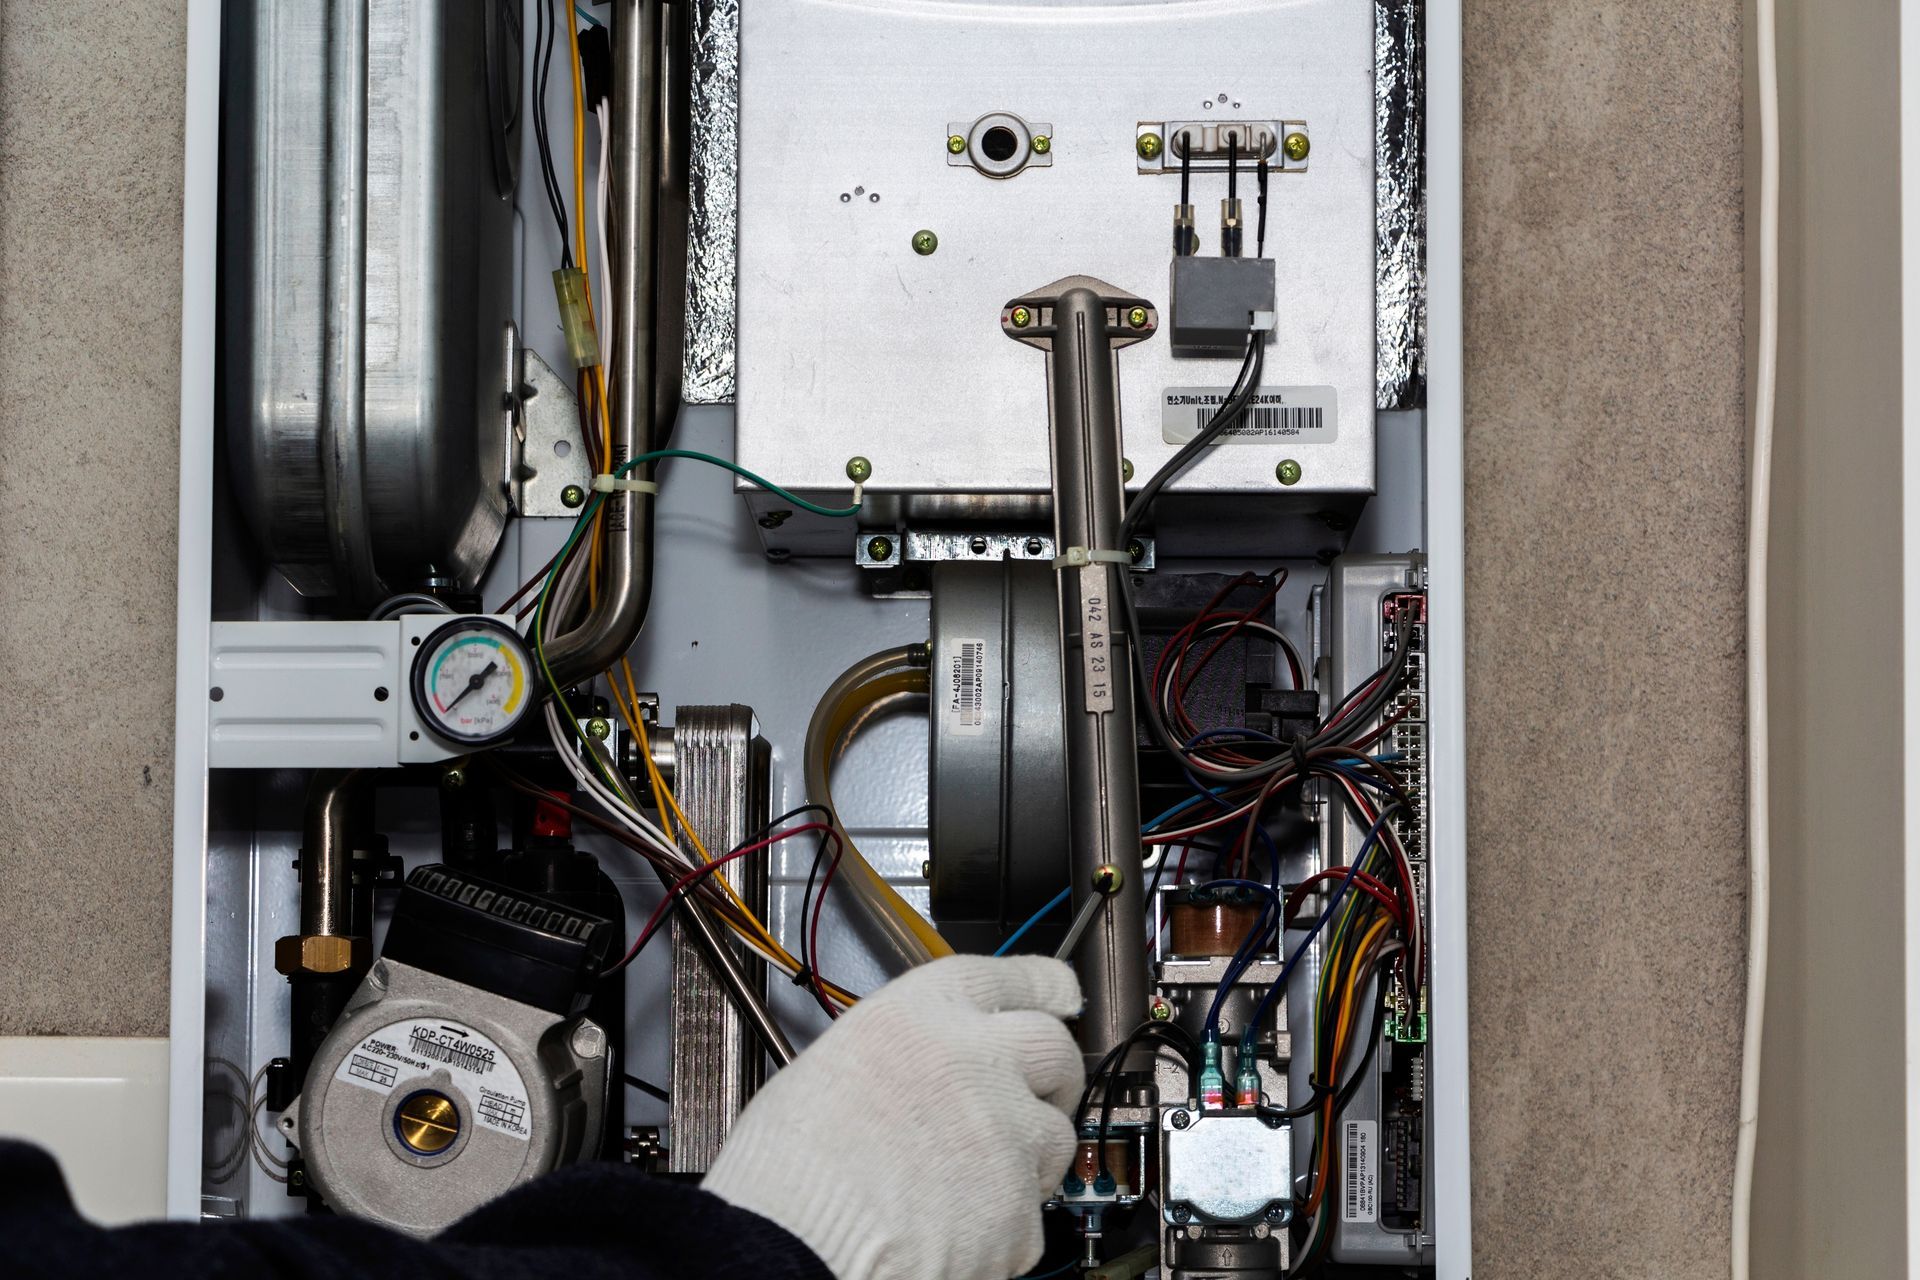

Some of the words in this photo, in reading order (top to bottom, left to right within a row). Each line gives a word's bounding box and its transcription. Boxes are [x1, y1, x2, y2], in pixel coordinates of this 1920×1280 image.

[1088, 598, 1101, 622] 042
[1090, 633, 1103, 649] AS
[1091, 658, 1105, 673] 23
[1093, 683, 1106, 698] 15
[370, 1039, 398, 1053] POWER:
[412, 1026, 496, 1061] KDP-CT4W0525
[479, 1086, 509, 1101] Circulation
[509, 1095, 527, 1107] Pump
[483, 1116, 501, 1127] MADE
